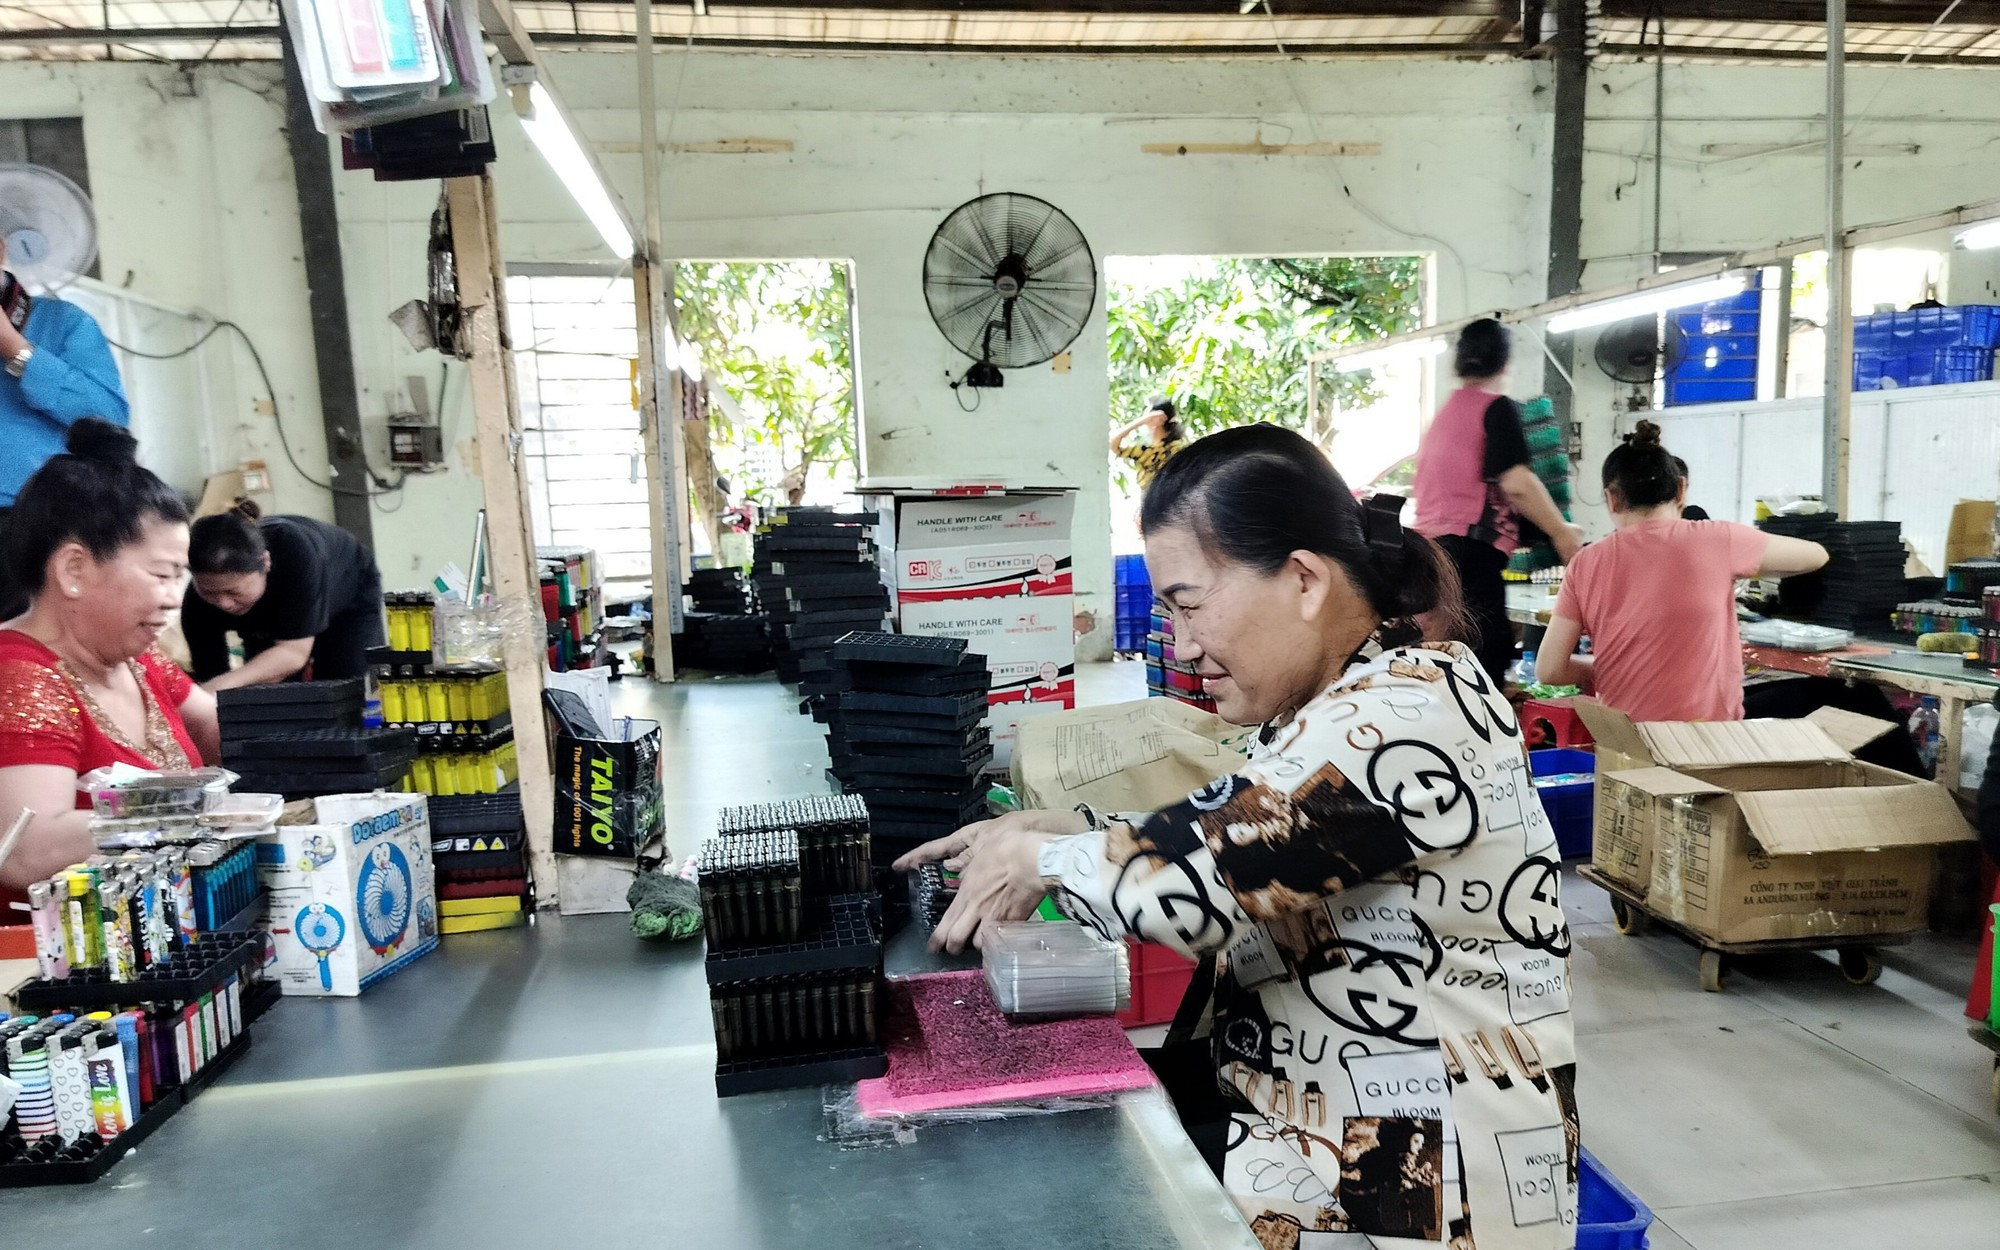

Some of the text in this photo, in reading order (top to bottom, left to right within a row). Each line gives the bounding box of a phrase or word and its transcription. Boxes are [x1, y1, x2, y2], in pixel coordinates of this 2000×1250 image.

[916, 514, 1003, 526] HANDLE WITH CARE
[909, 562, 927, 576] CR
[918, 618, 1004, 630] HANDLE WITH CARE
[573, 746, 583, 762] The
[571, 763, 583, 790] magic
[590, 756, 614, 845] TAIYO
[571, 823, 582, 848] lights
[1778, 882, 1789, 891] TY
[1342, 905, 1413, 923] GUCC
